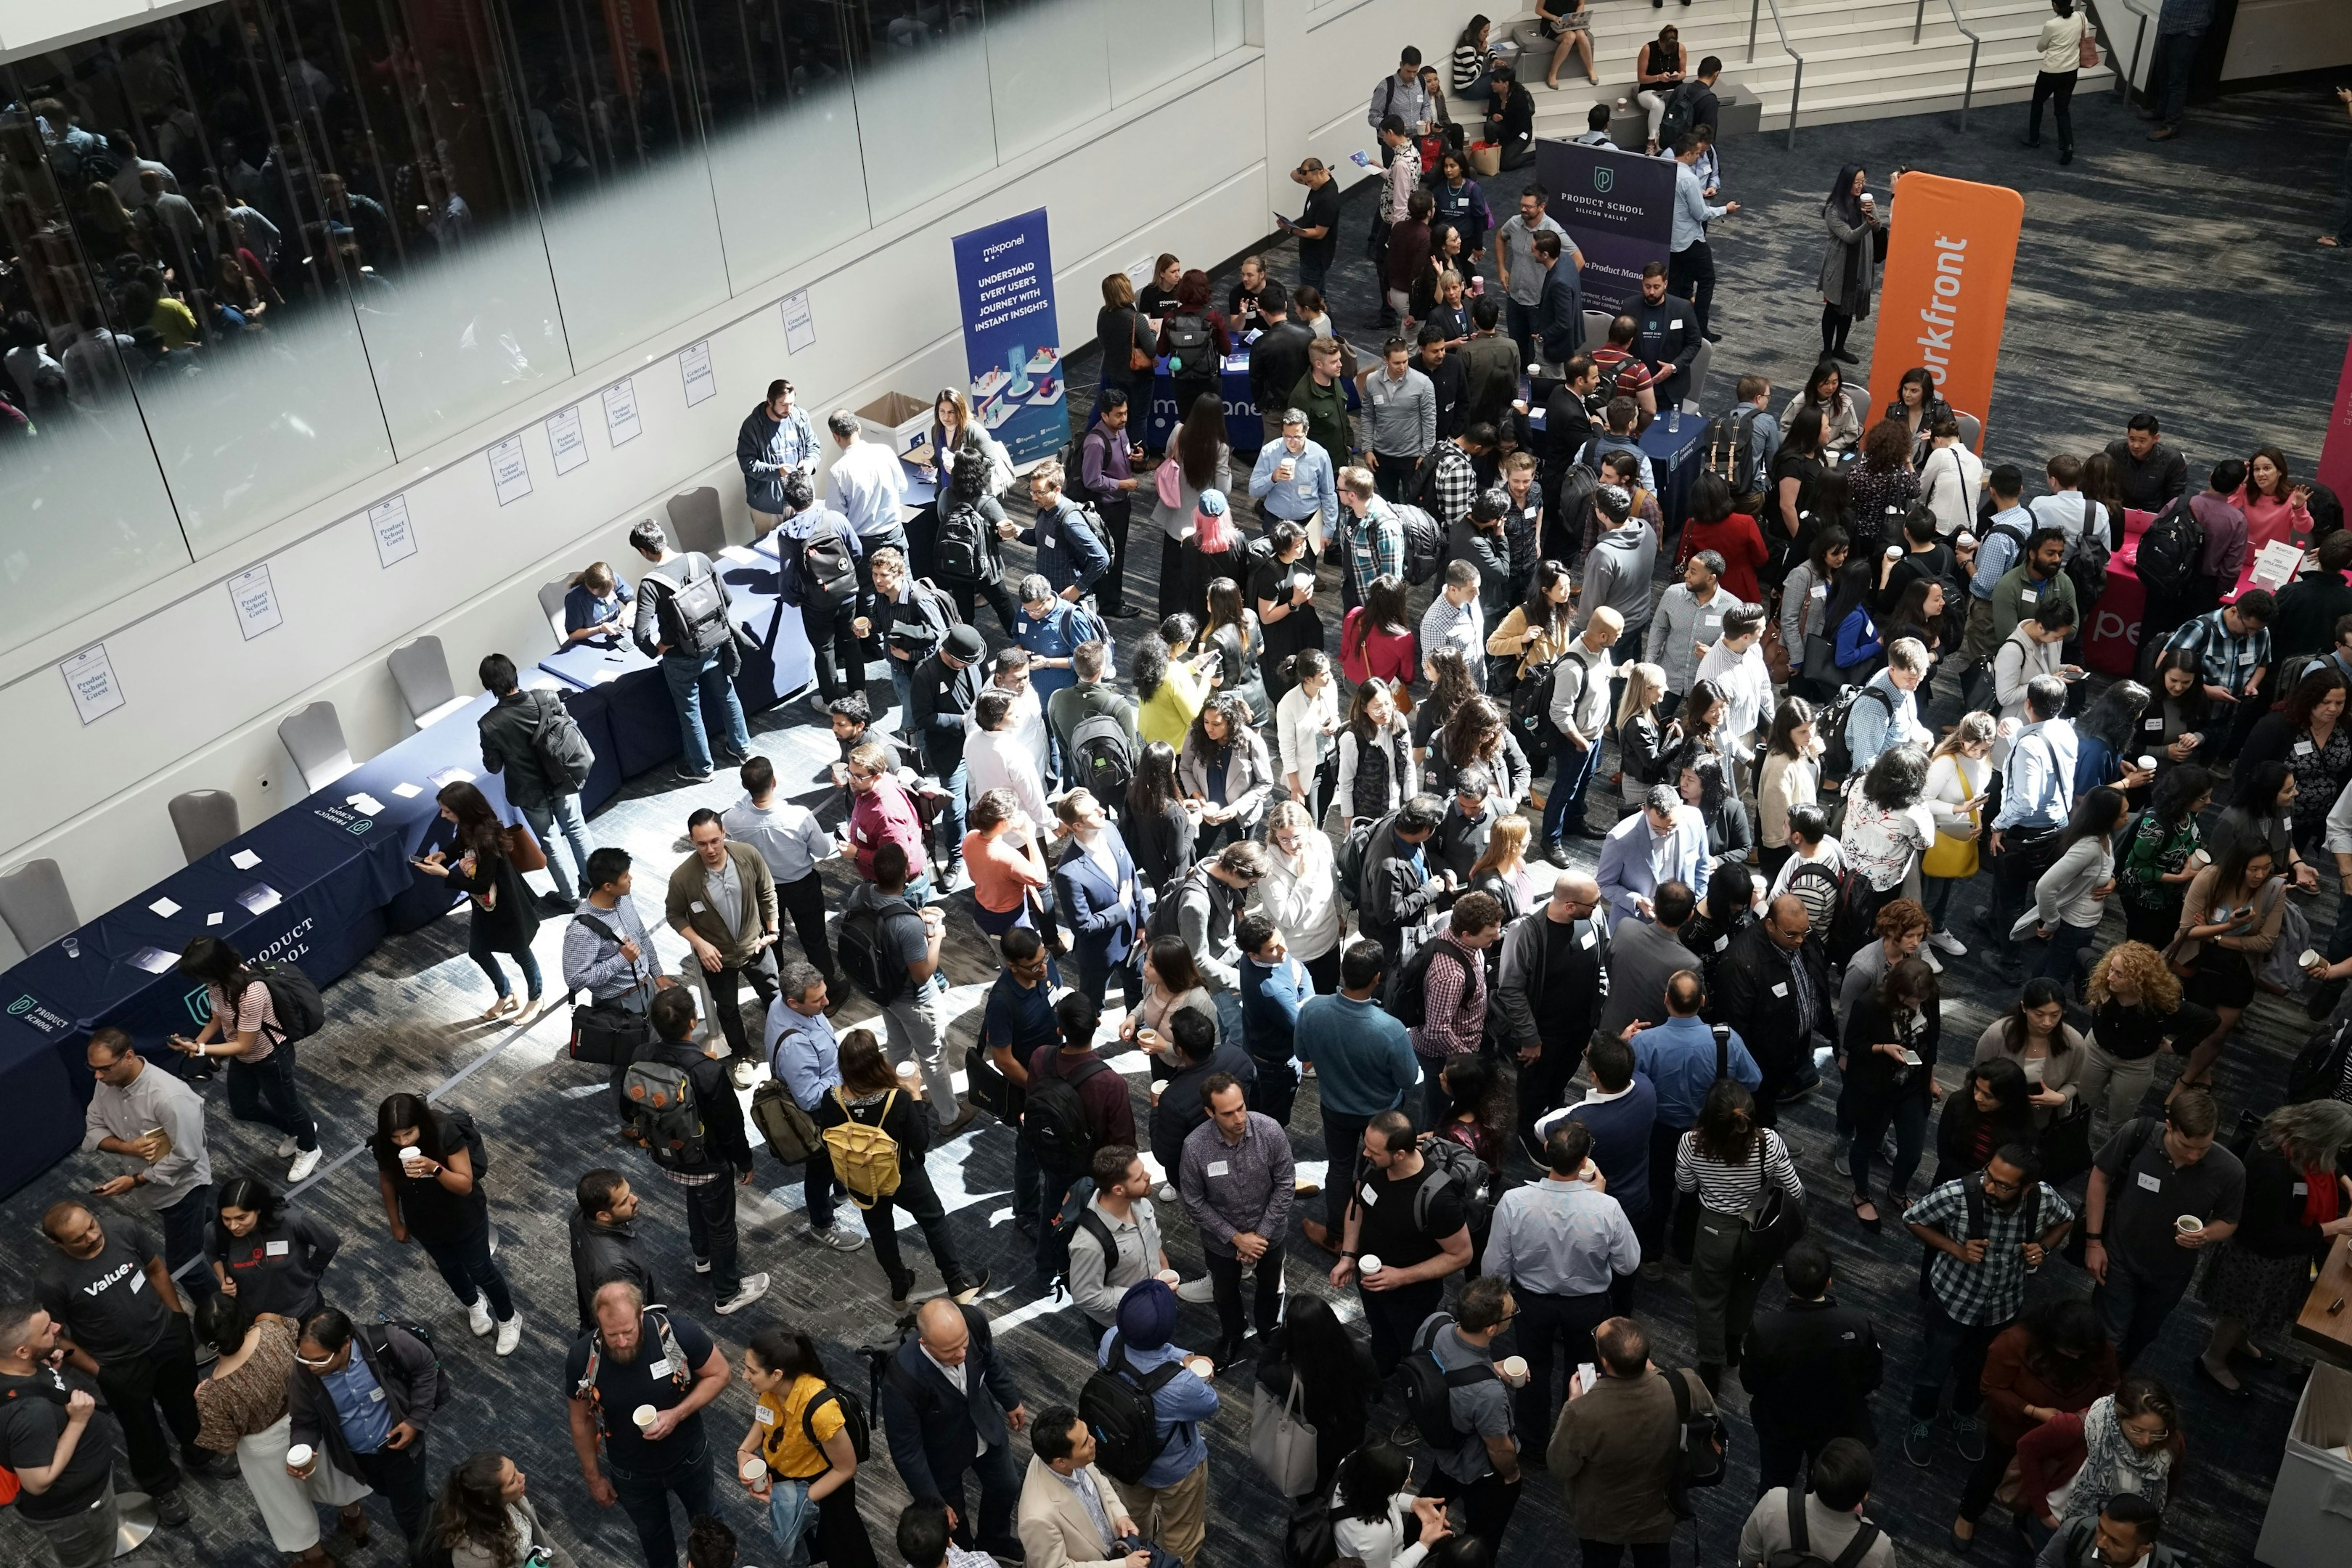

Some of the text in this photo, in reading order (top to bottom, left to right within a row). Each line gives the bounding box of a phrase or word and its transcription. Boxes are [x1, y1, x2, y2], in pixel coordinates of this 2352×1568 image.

[1561, 192, 1644, 216] PRODUCT SCHOOL
[1575, 207, 1628, 222] SILICON VALLEY
[983, 233, 1025, 256] mixpanel
[978, 262, 1035, 287] UNDERSTAND
[1591, 262, 1620, 275] Product
[1621, 269, 1643, 280] Mana
[980, 275, 1037, 302] EVERY USER'S
[979, 288, 1041, 317] JOURNEY WITH
[1601, 295, 1621, 305] Coding,
[788, 312, 807, 326] General
[975, 299, 1048, 332] INSTANT INSIGHTS
[1916, 236, 1967, 400] orkfront
[787, 317, 811, 333] Admission
[685, 369, 711, 385] Admission
[687, 364, 707, 377] General
[612, 403, 630, 416] Product
[614, 409, 630, 420] School
[611, 412, 637, 429] Community
[557, 430, 576, 444] Product
[559, 436, 575, 448] School
[555, 440, 582, 457] Community
[499, 460, 519, 474] Product
[502, 466, 518, 478] School
[497, 470, 526, 487] Community
[380, 520, 405, 536] Product
[383, 527, 404, 542] School
[386, 534, 405, 547] Guest
[2279, 547, 2294, 555] pendo
[241, 590, 268, 608] Product
[245, 597, 268, 613] School
[249, 604, 269, 618] Guest
[76, 671, 107, 690] Product
[82, 678, 107, 696] School
[86, 686, 108, 701] Guest
[314, 810, 348, 826] PRODUCT
[328, 807, 355, 821] SCHOOL
[247, 917, 313, 965] ODUCT
[25, 1014, 53, 1032] SCHOOL
[34, 1007, 69, 1028] PRODUCT
[2141, 1177, 2155, 1188] ERIK
[83, 1264, 129, 1296] Value
